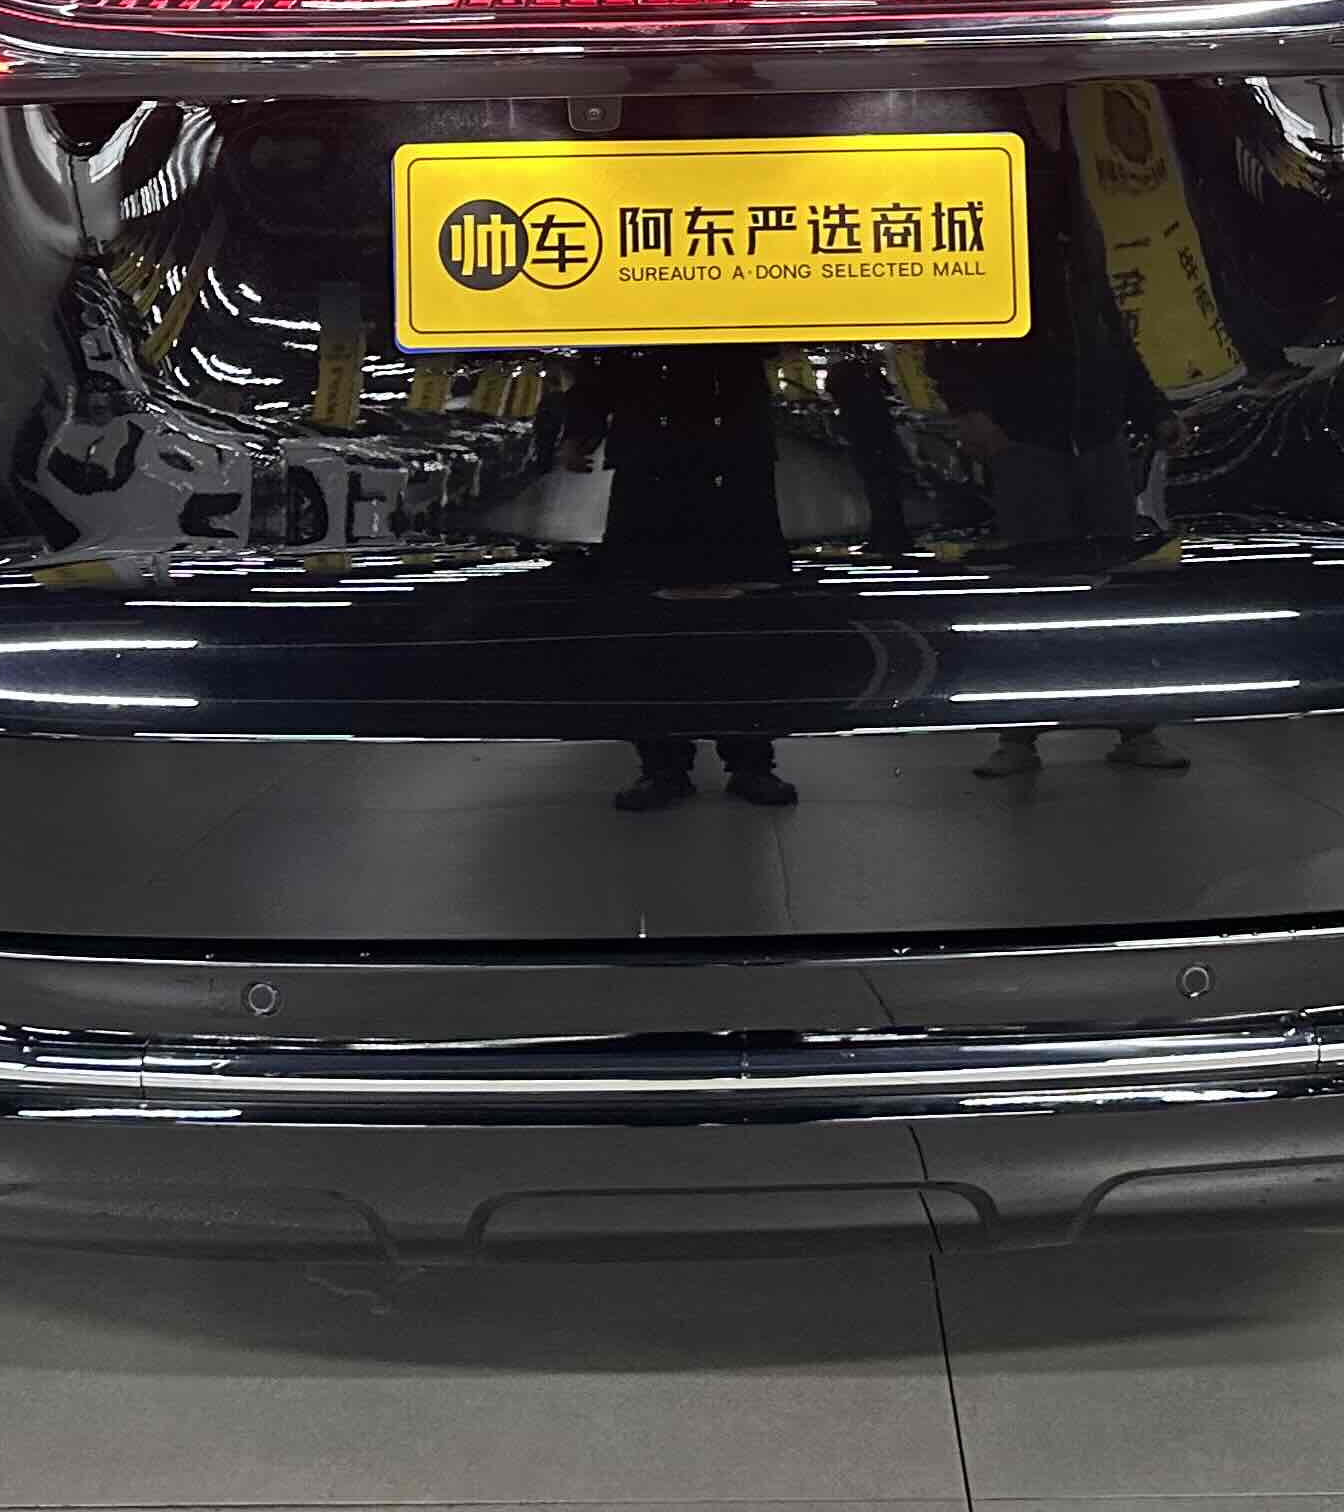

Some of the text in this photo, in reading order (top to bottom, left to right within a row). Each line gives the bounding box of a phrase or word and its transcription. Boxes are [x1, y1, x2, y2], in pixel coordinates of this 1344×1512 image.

[446, 210, 592, 278] 帅车
[618, 201, 985, 258] 阿东严选商城
[619, 265, 722, 282] SUREAUTO
[822, 262, 924, 279] SELECTED
[933, 261, 986, 277] MALL
